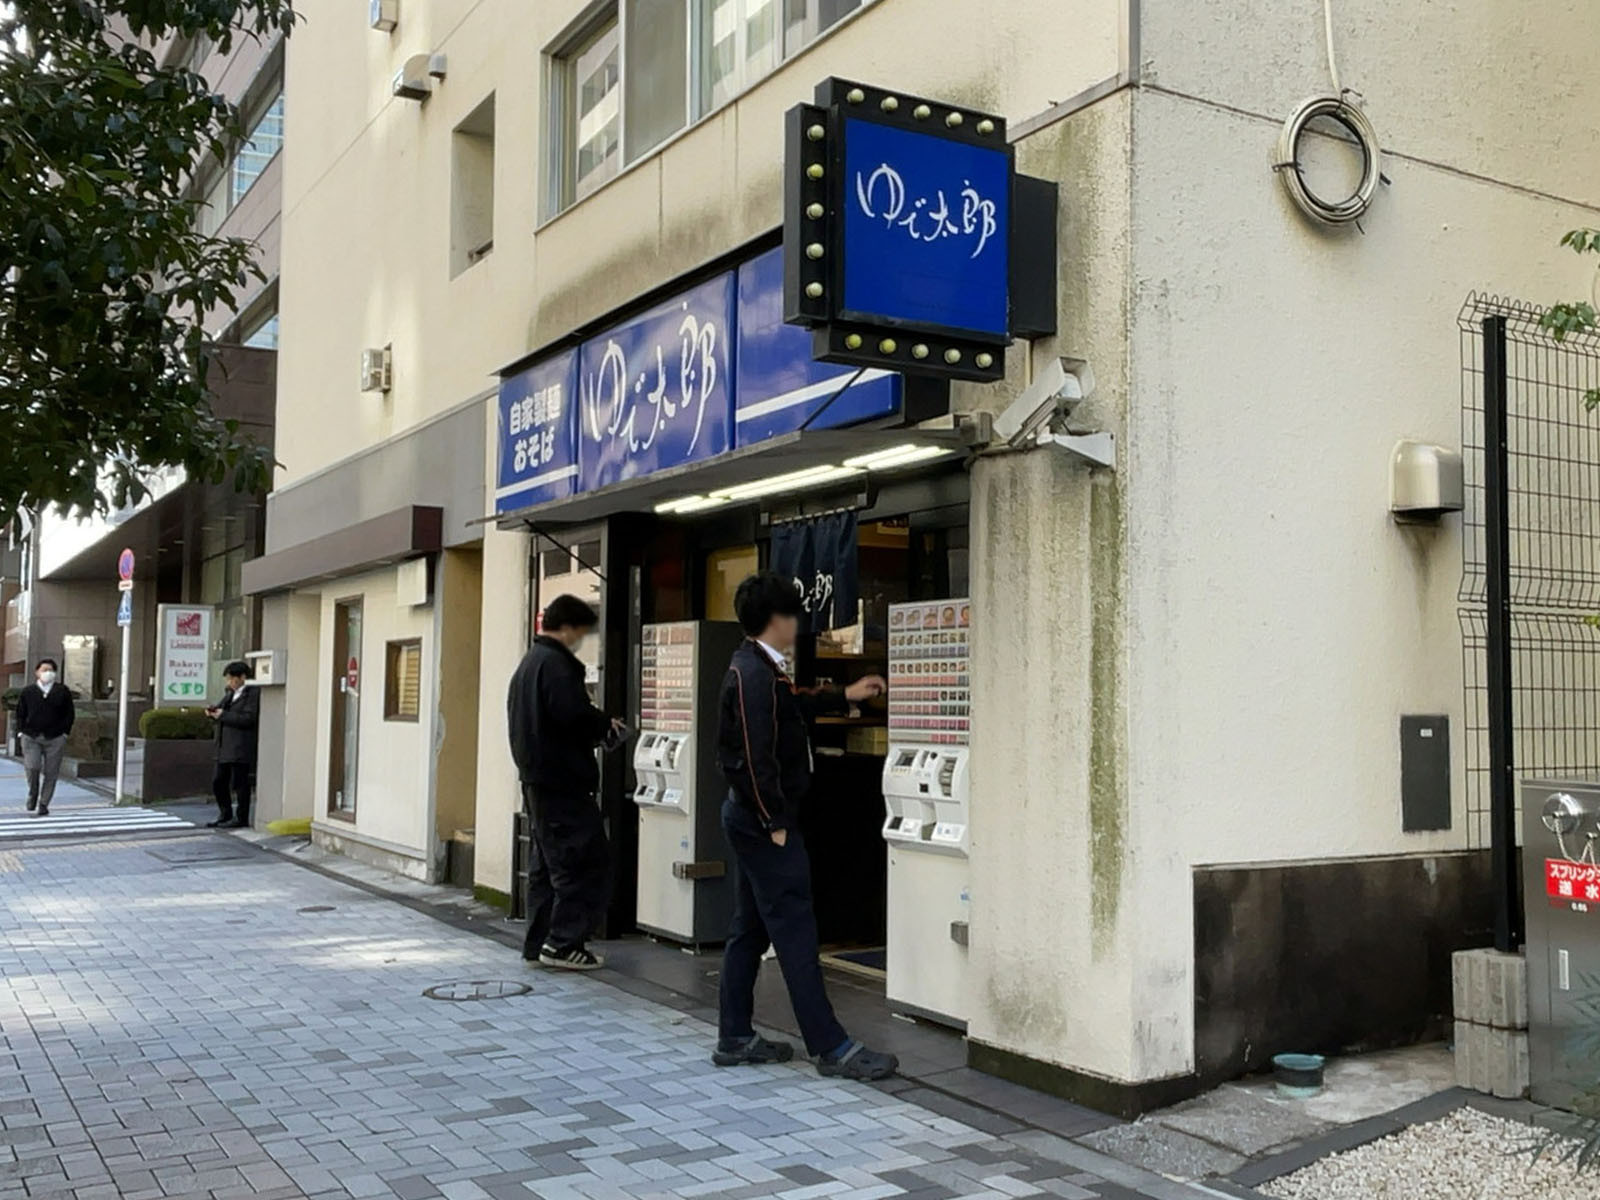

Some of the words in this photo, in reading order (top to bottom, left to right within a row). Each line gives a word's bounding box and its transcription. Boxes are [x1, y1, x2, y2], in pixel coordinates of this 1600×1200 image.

[857, 163, 996, 258] ゆで太郎
[590, 302, 717, 456] ゆで太郎
[510, 384, 562, 435] 自家製麺
[514, 426, 555, 474] おそば
[168, 681, 204, 695] くすり
